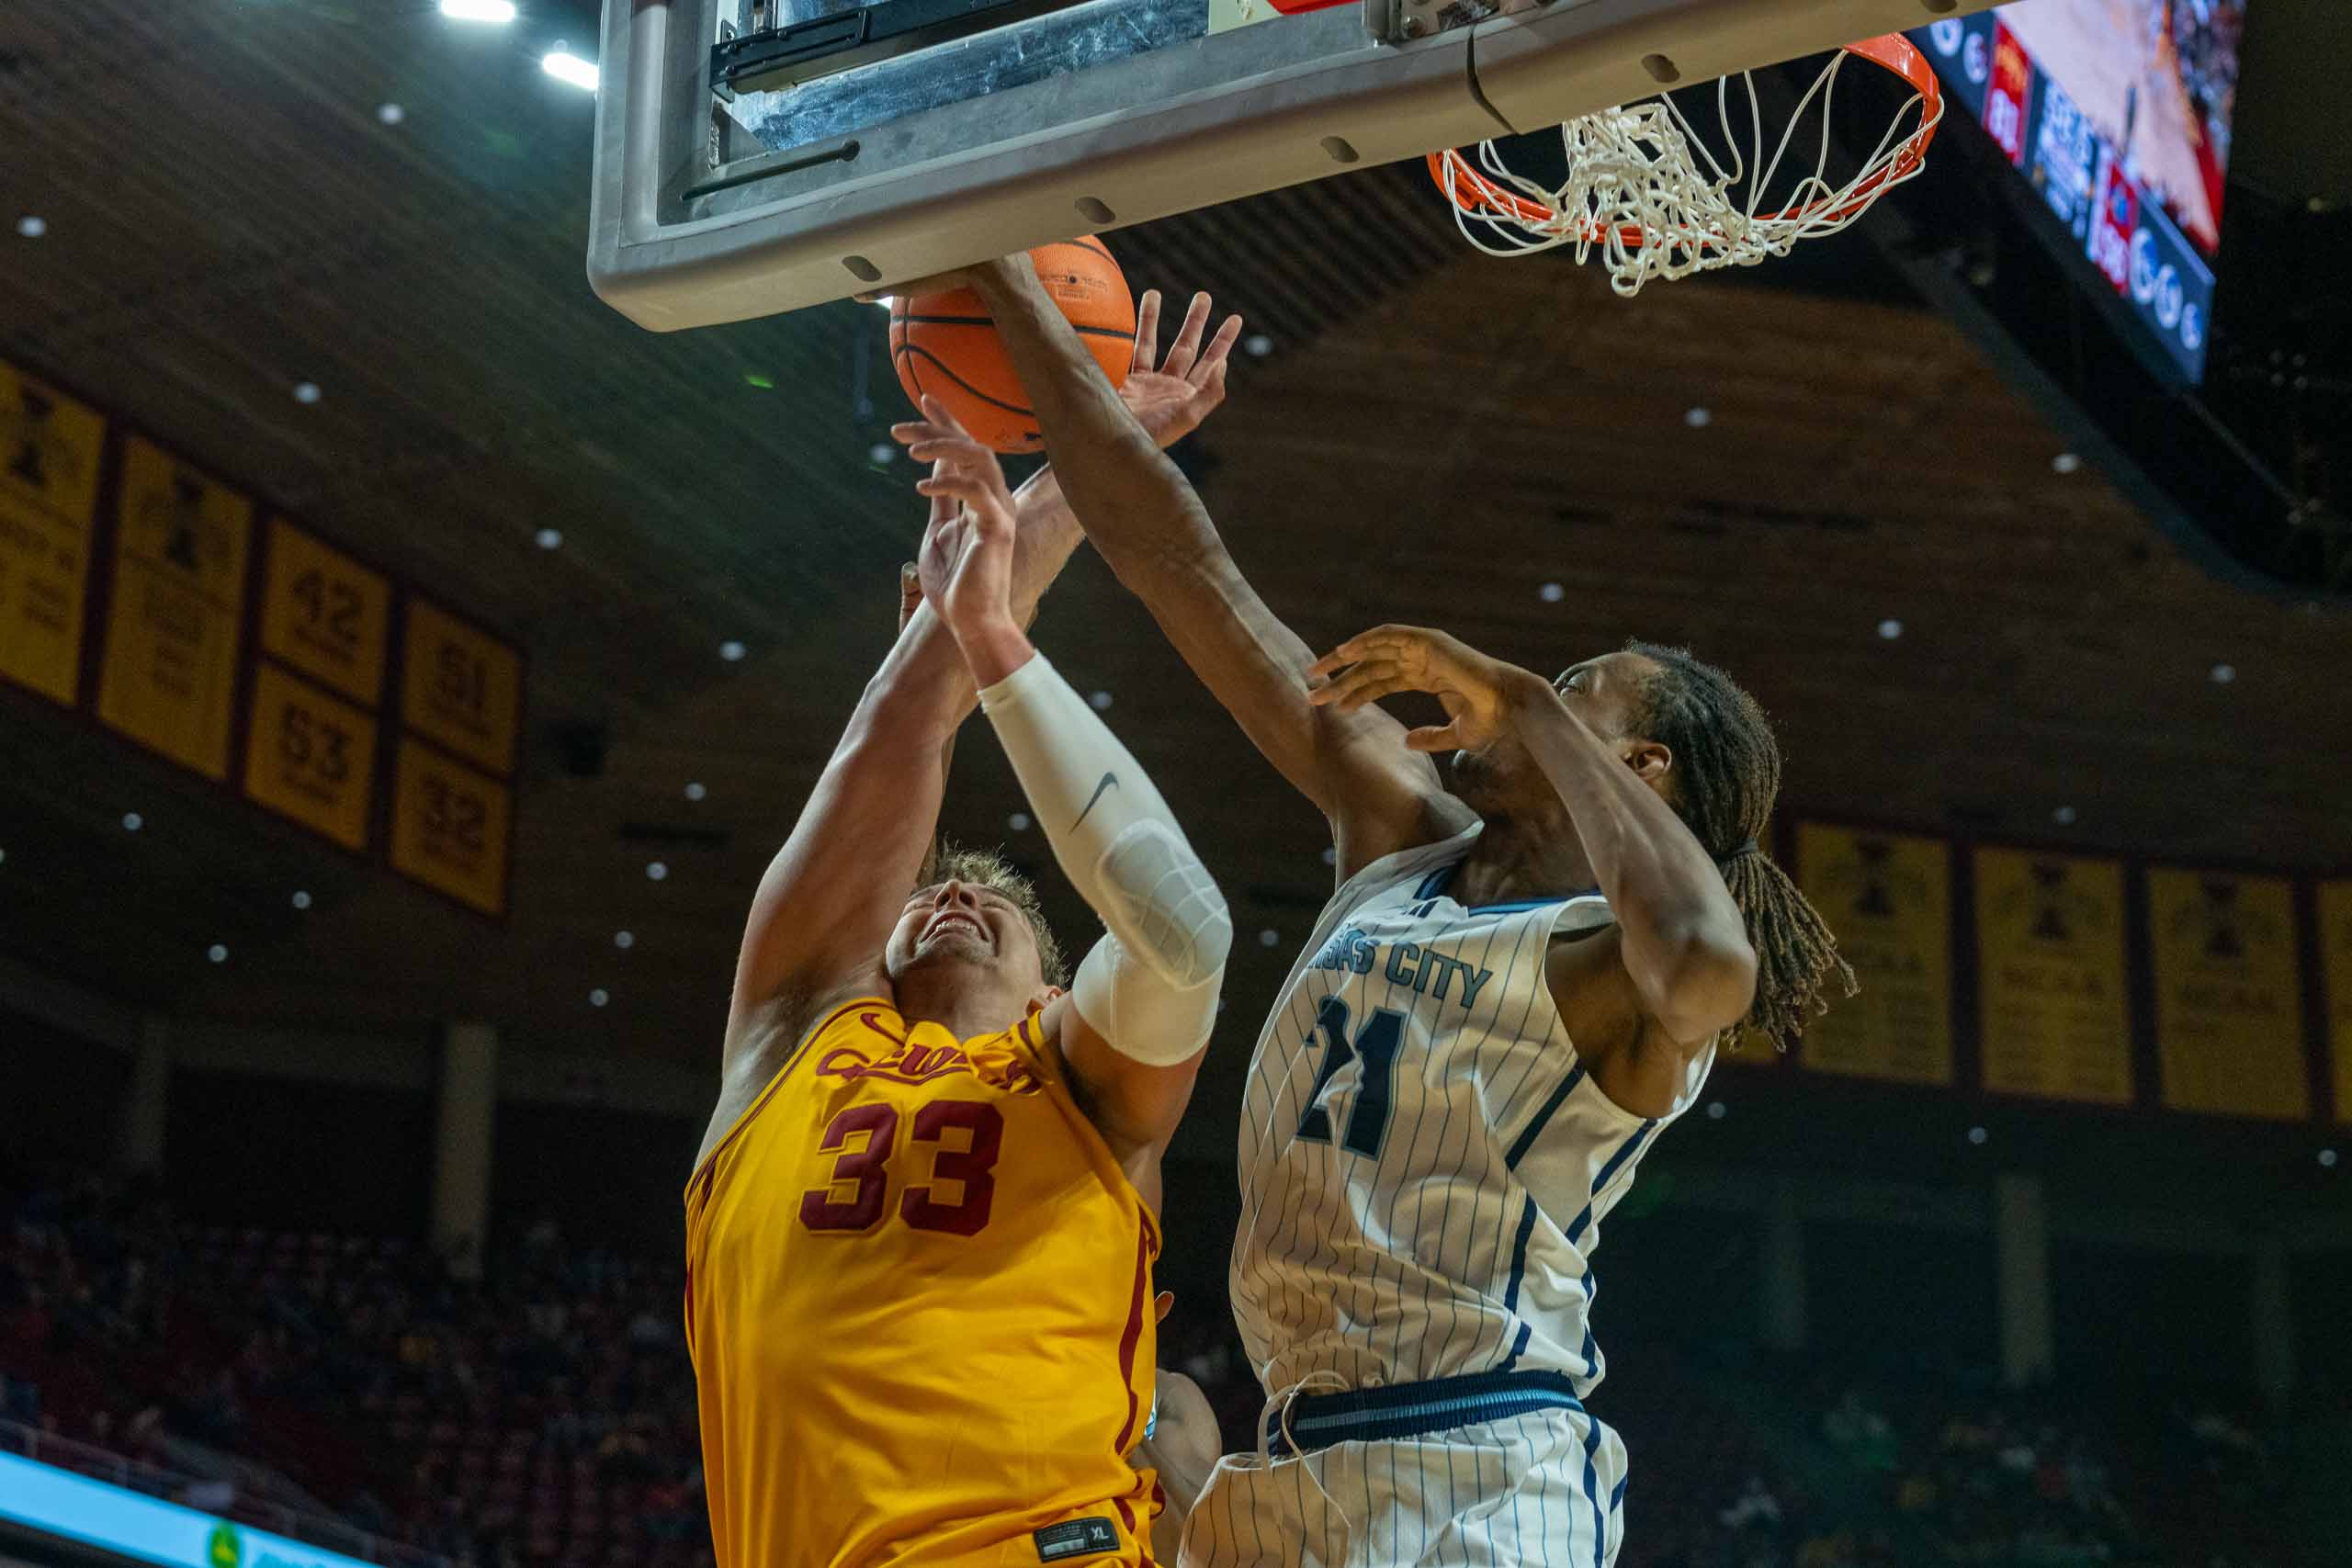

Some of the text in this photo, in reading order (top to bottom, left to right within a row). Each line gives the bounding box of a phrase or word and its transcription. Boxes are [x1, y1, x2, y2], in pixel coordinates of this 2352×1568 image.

[1385, 940, 1493, 1010] CITY
[797, 1099, 1005, 1237] 33
[1091, 1526, 1110, 1541] XL
